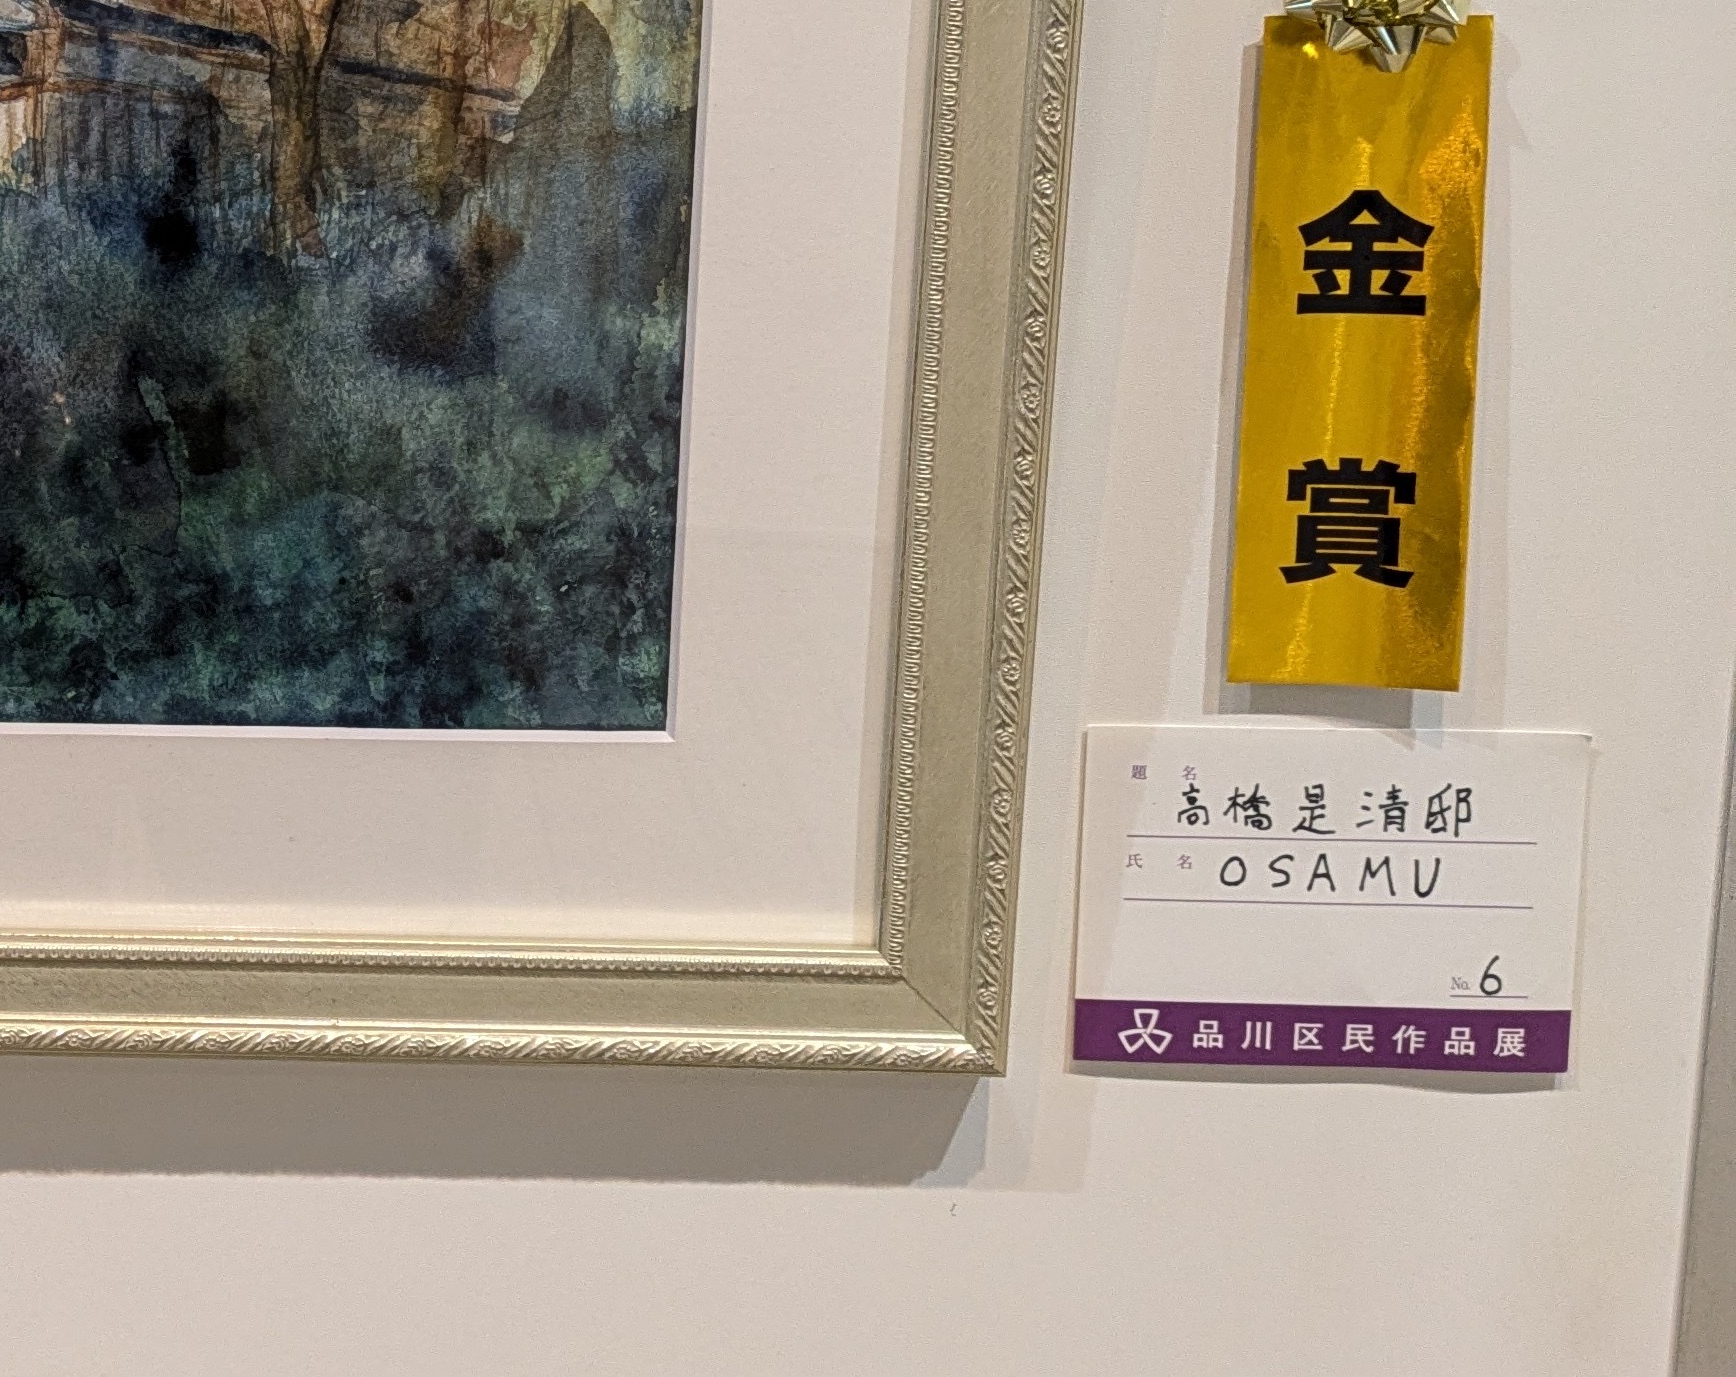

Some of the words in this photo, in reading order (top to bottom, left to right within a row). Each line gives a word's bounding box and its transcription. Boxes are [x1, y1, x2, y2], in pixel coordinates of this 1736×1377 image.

[1279, 189, 1435, 589] 金賞
[1176, 783, 1474, 837] 高橋是清邸
[1219, 853, 1442, 898] OSAMU
[1479, 955, 1502, 996] 6
[1192, 1020, 1527, 1057] 品川区民作品展
